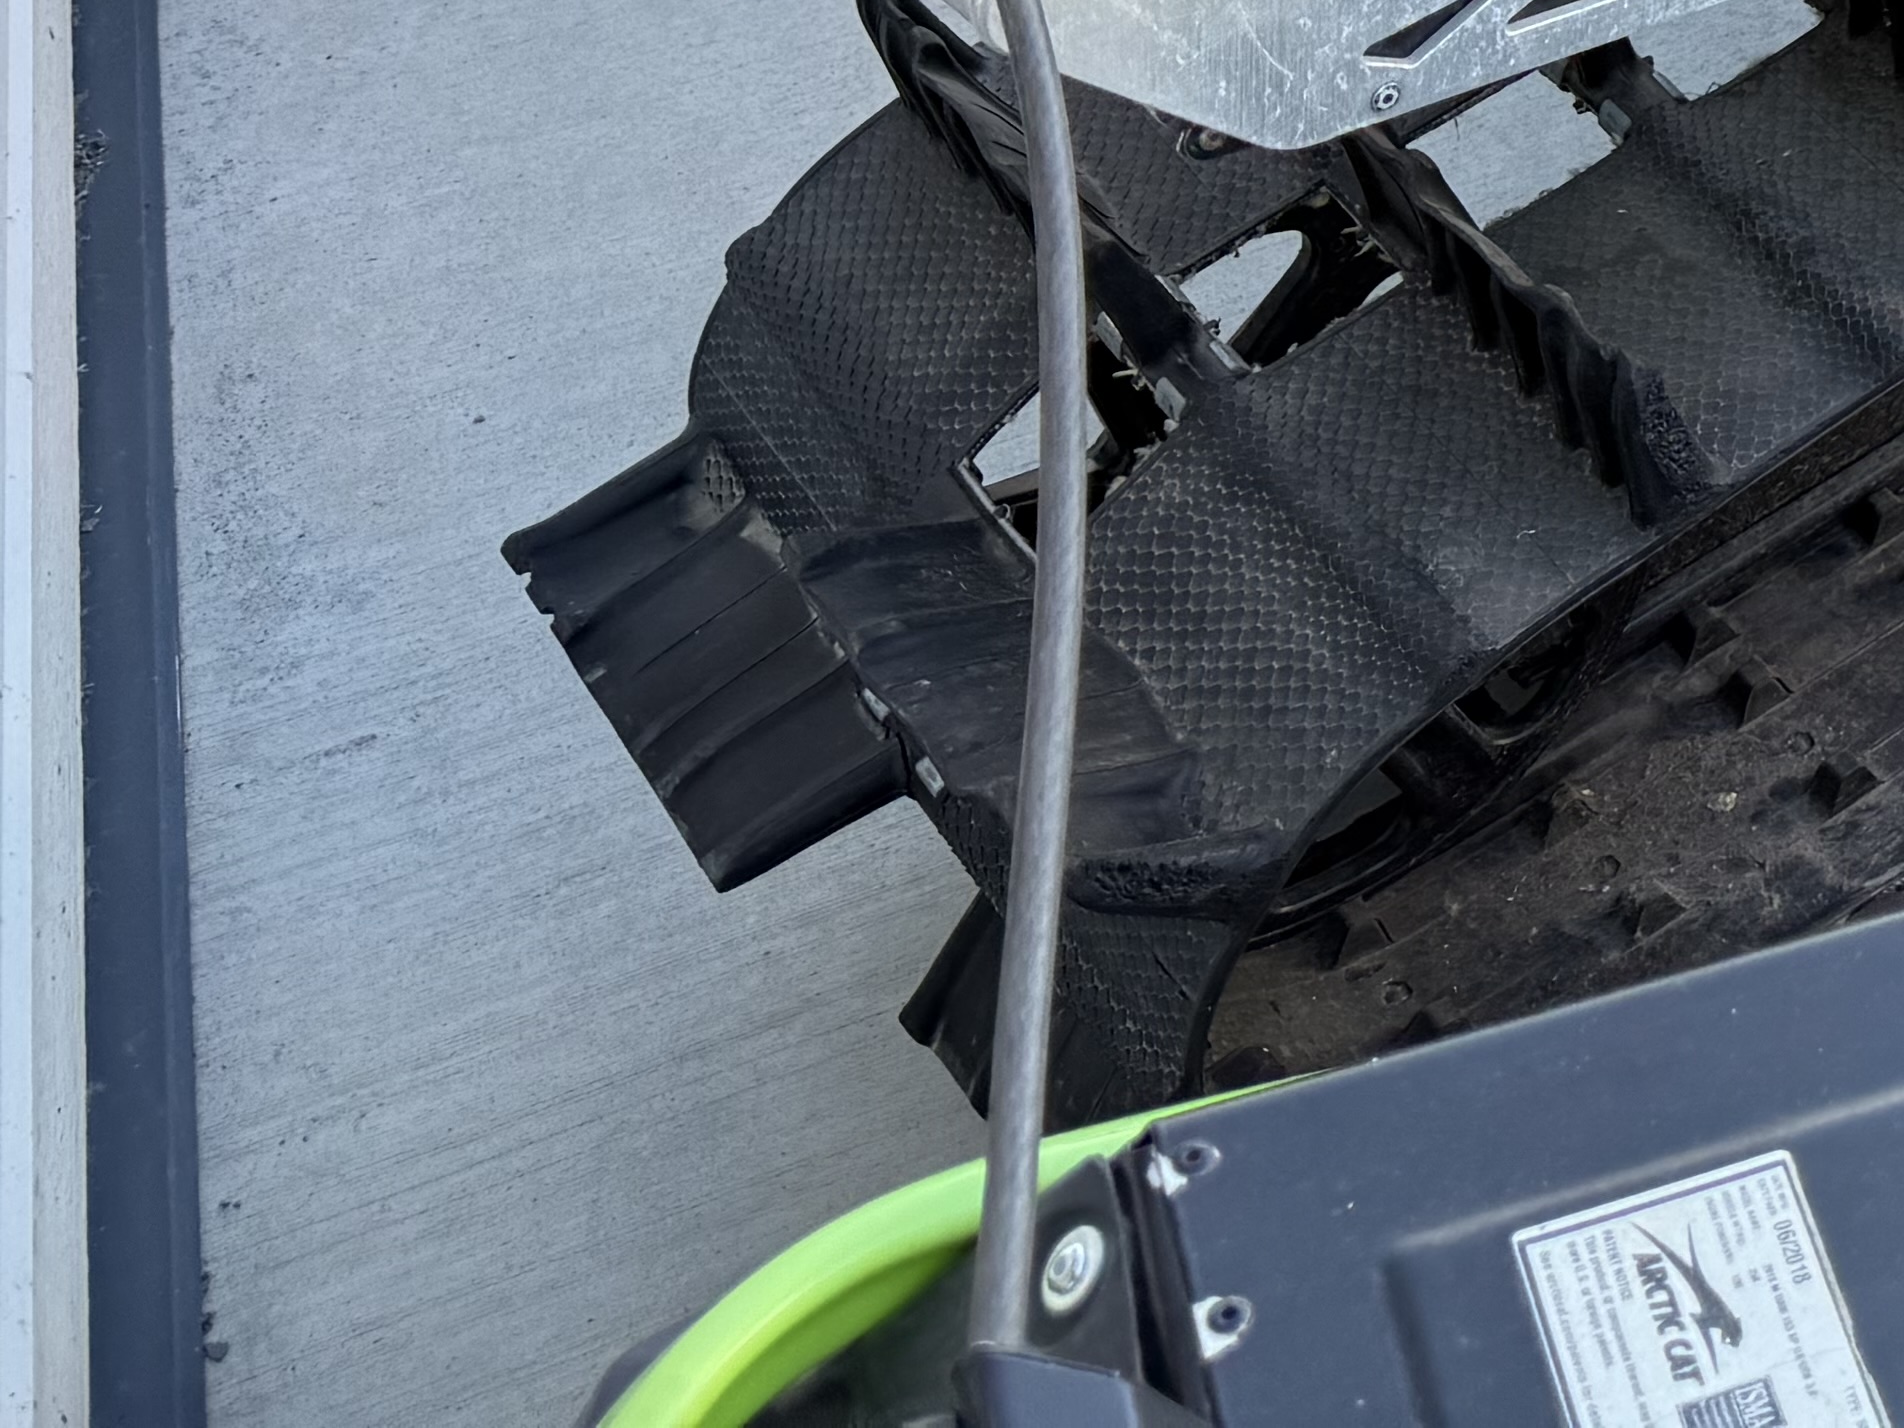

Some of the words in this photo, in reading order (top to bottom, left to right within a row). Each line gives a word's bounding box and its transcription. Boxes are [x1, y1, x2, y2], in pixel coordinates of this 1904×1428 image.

[1599, 1227, 1622, 1267] PATENT
[1612, 1266, 1634, 1303] NOTICE
[1772, 1218, 1813, 1286] 06/2018
[1632, 1250, 1687, 1337] ARCTIC
[1663, 1335, 1705, 1387] CAT
